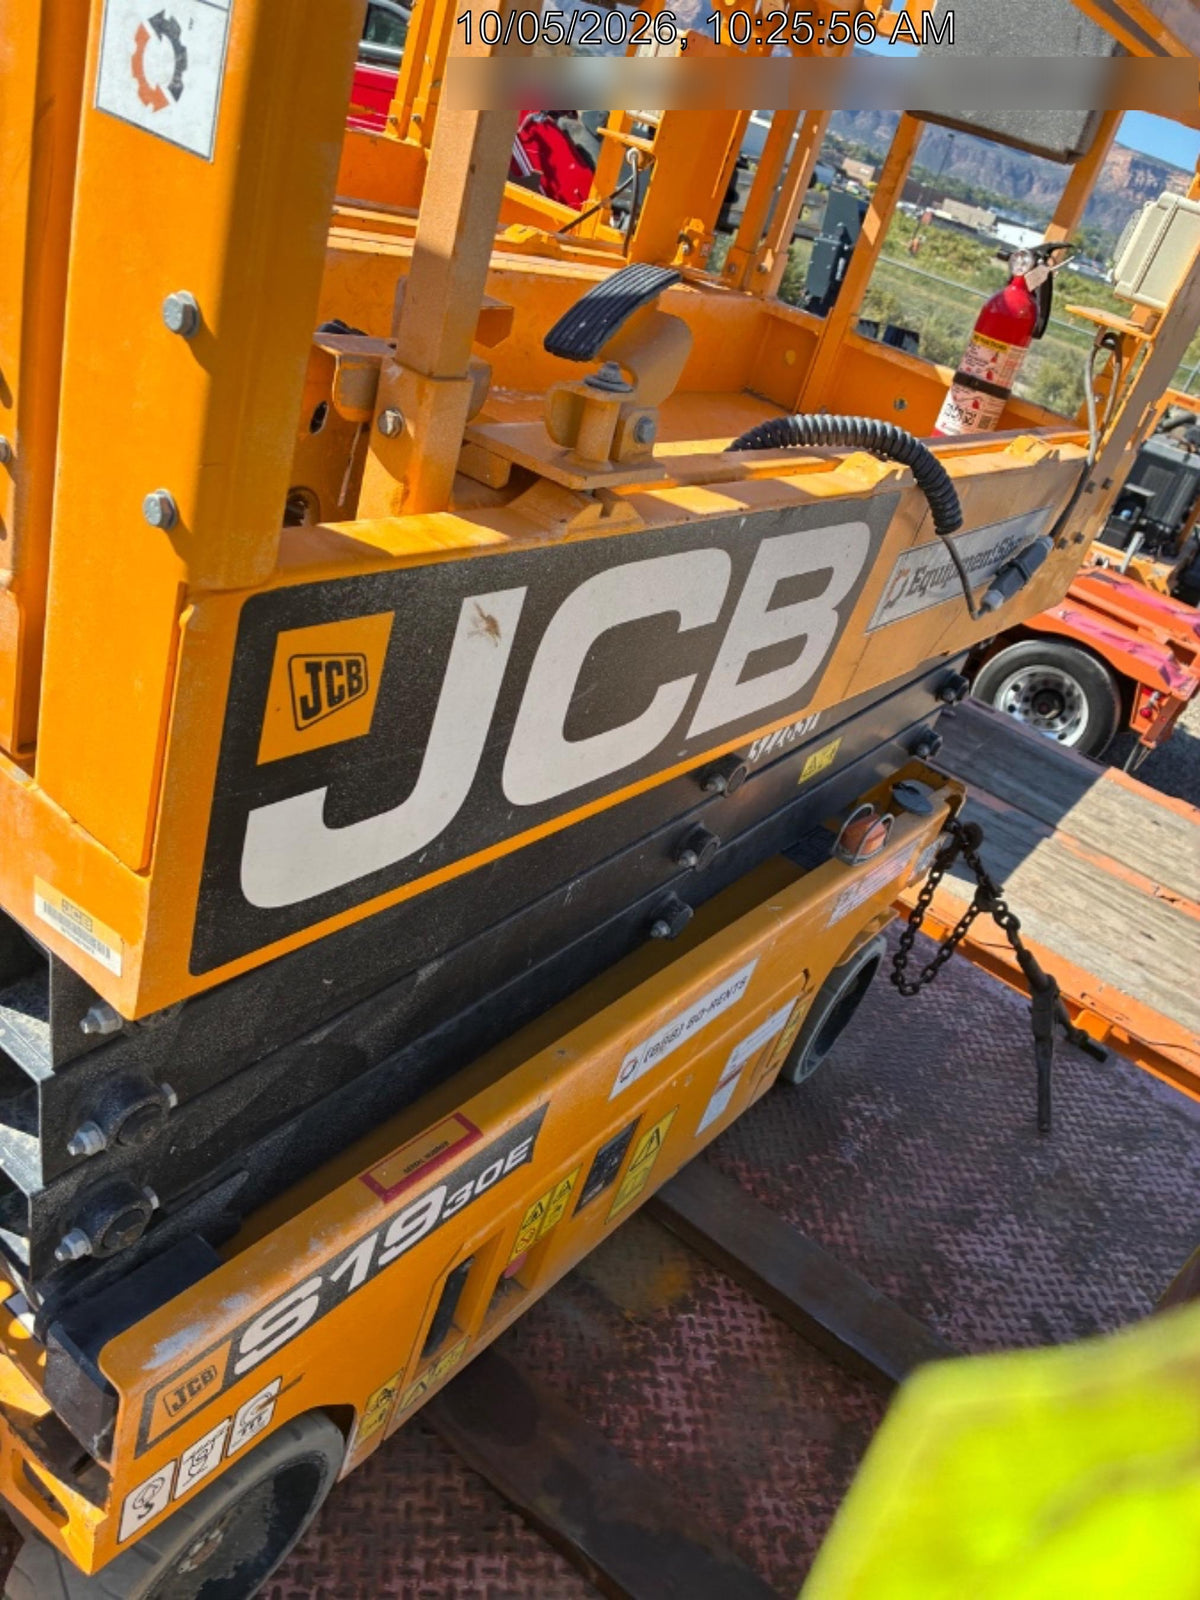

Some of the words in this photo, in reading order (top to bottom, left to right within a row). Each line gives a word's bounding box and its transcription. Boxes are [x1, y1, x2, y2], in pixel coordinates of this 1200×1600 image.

[240, 521, 871, 909] JCB
[300, 658, 363, 721] JCB
[171, 1367, 216, 1412] JCB
